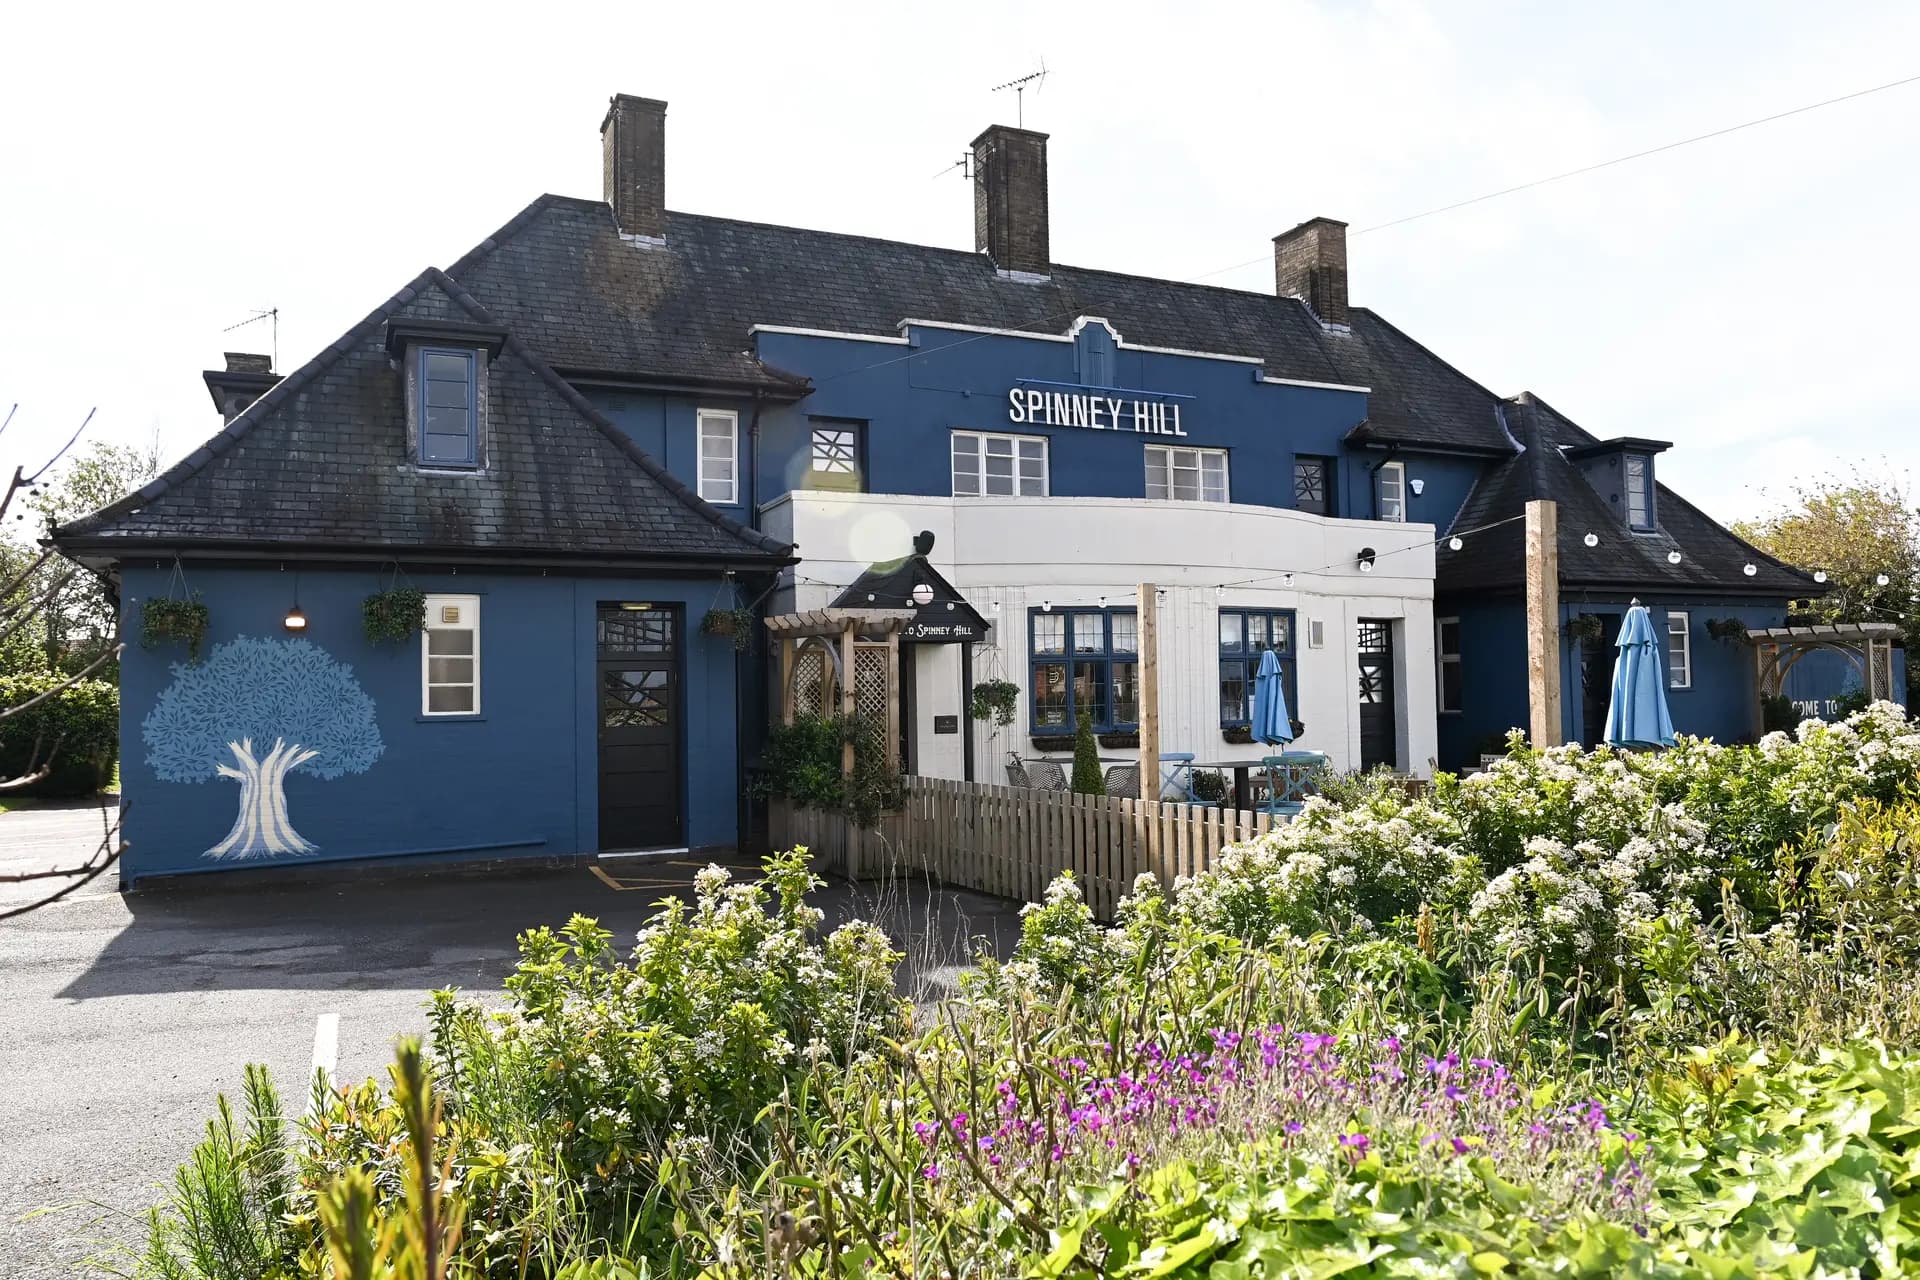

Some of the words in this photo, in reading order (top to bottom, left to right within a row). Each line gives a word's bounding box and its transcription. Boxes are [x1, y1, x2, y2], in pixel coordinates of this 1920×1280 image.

[1009, 388, 1122, 430] SPINNEY
[1134, 400, 1187, 436] HILL
[1825, 699, 1837, 714] TO
